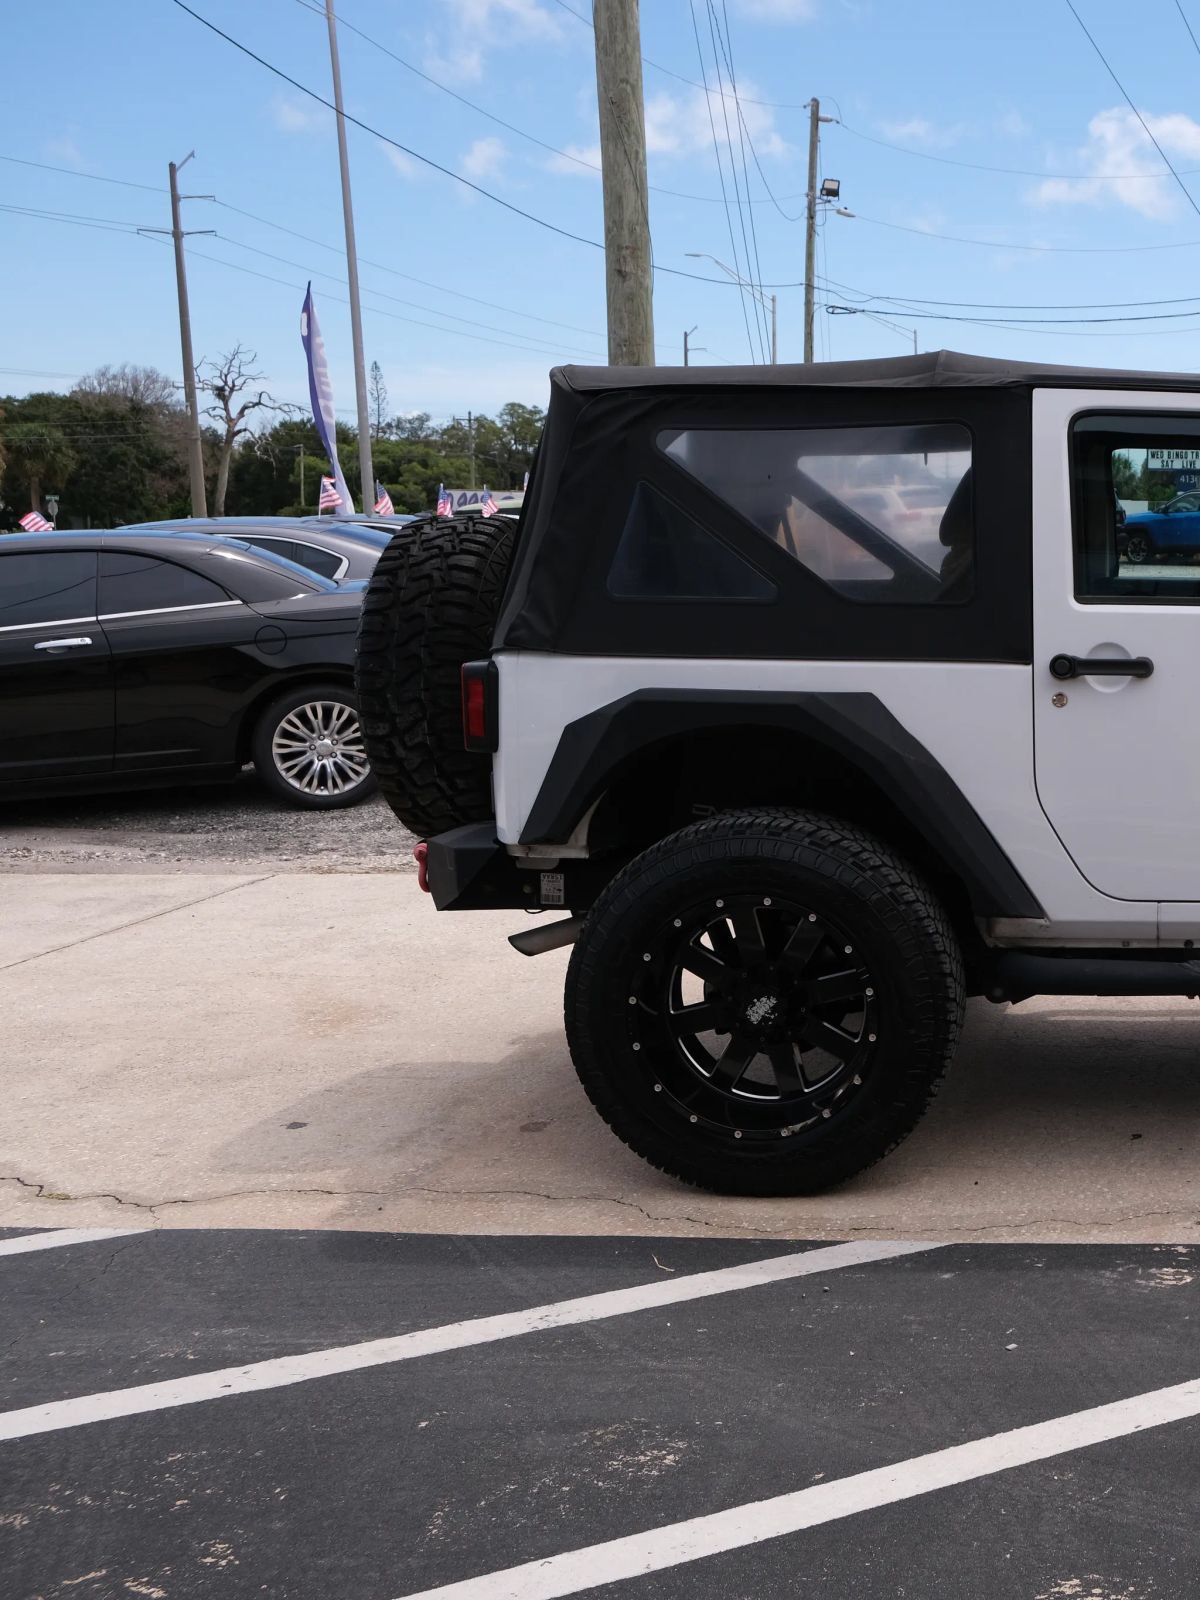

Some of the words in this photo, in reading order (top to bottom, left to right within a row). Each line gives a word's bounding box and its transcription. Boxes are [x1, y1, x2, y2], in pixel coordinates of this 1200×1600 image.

[1150, 450, 1164, 459] WED
[1167, 451, 1188, 460] BINGO
[1161, 460, 1174, 469] SAT
[1182, 460, 1196, 469] LIVE
